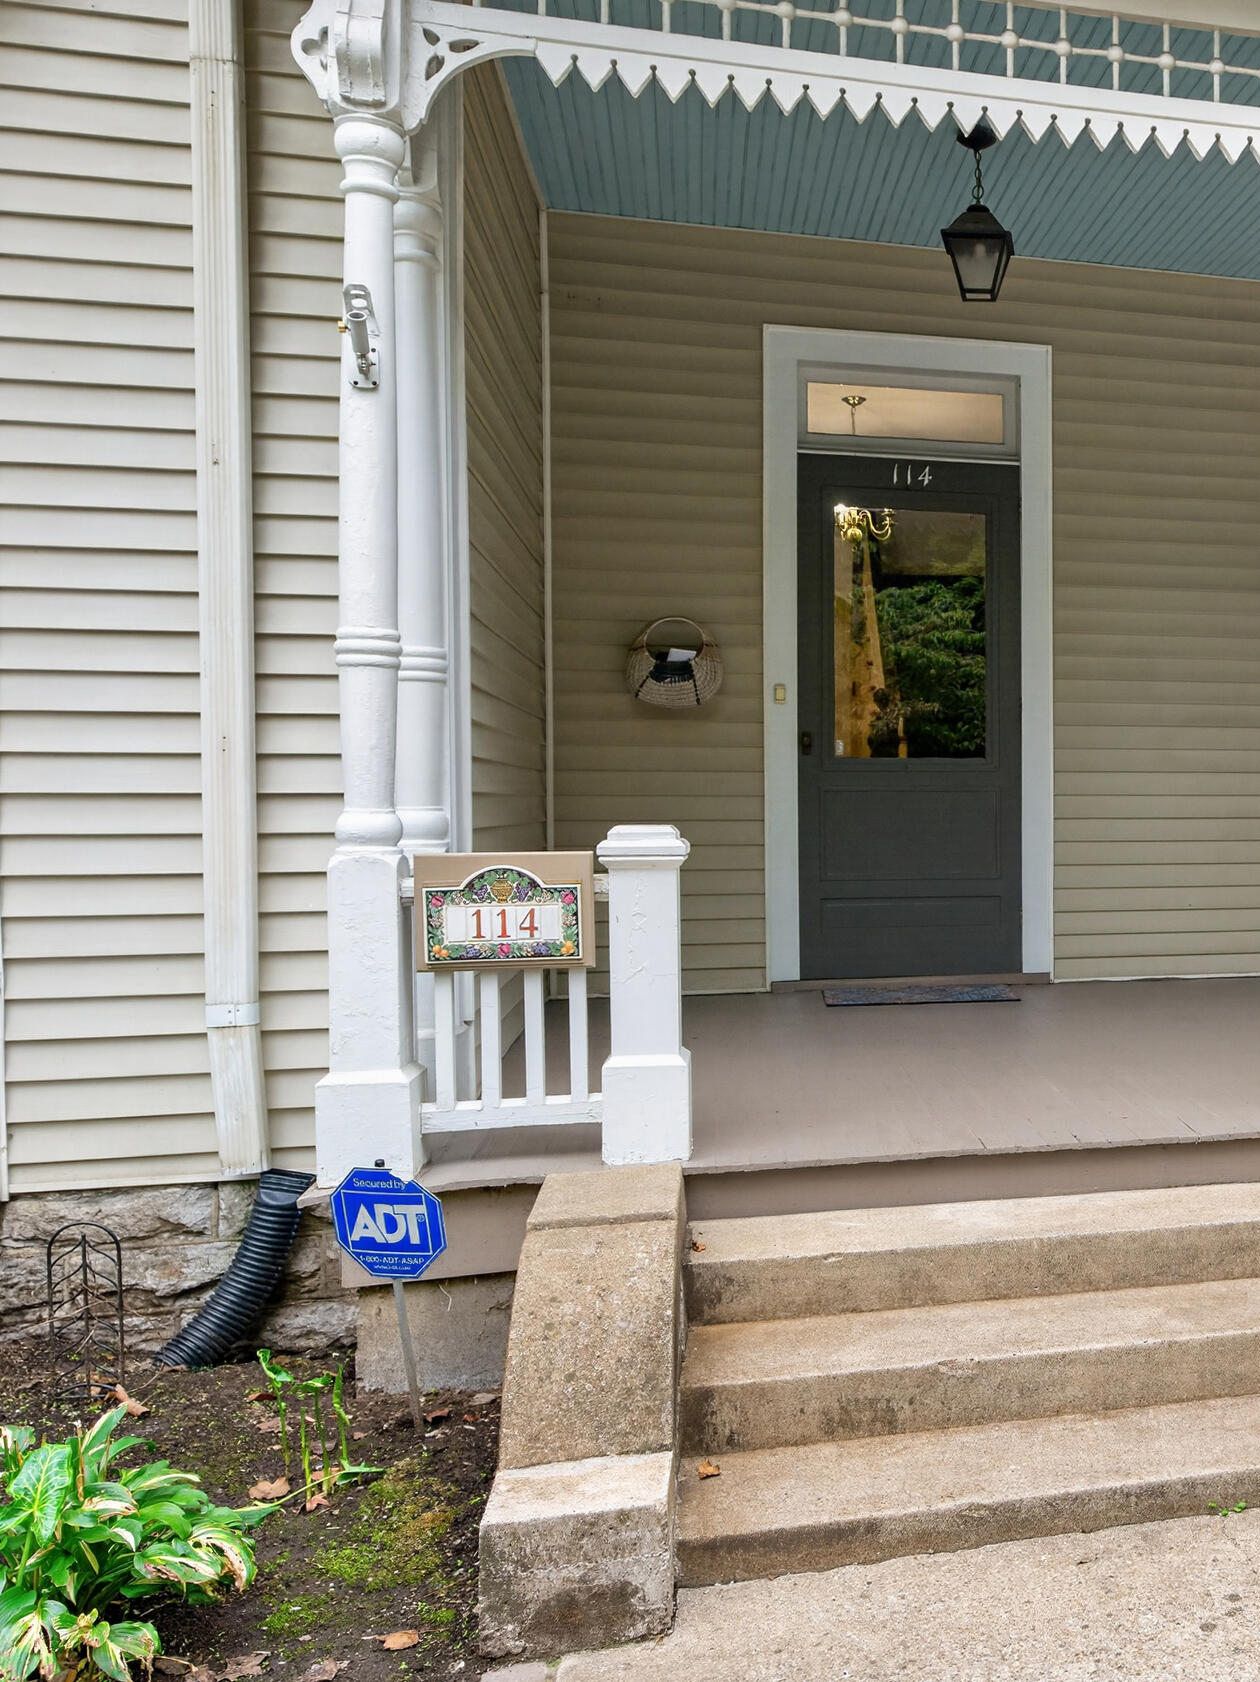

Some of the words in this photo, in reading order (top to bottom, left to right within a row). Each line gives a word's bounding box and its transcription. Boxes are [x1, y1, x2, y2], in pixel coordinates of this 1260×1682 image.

[893, 463, 933, 487] 114
[471, 908, 539, 939] 114
[353, 1178, 392, 1189] Secured
[393, 1179, 406, 1191] by
[350, 1203, 425, 1244] ADT
